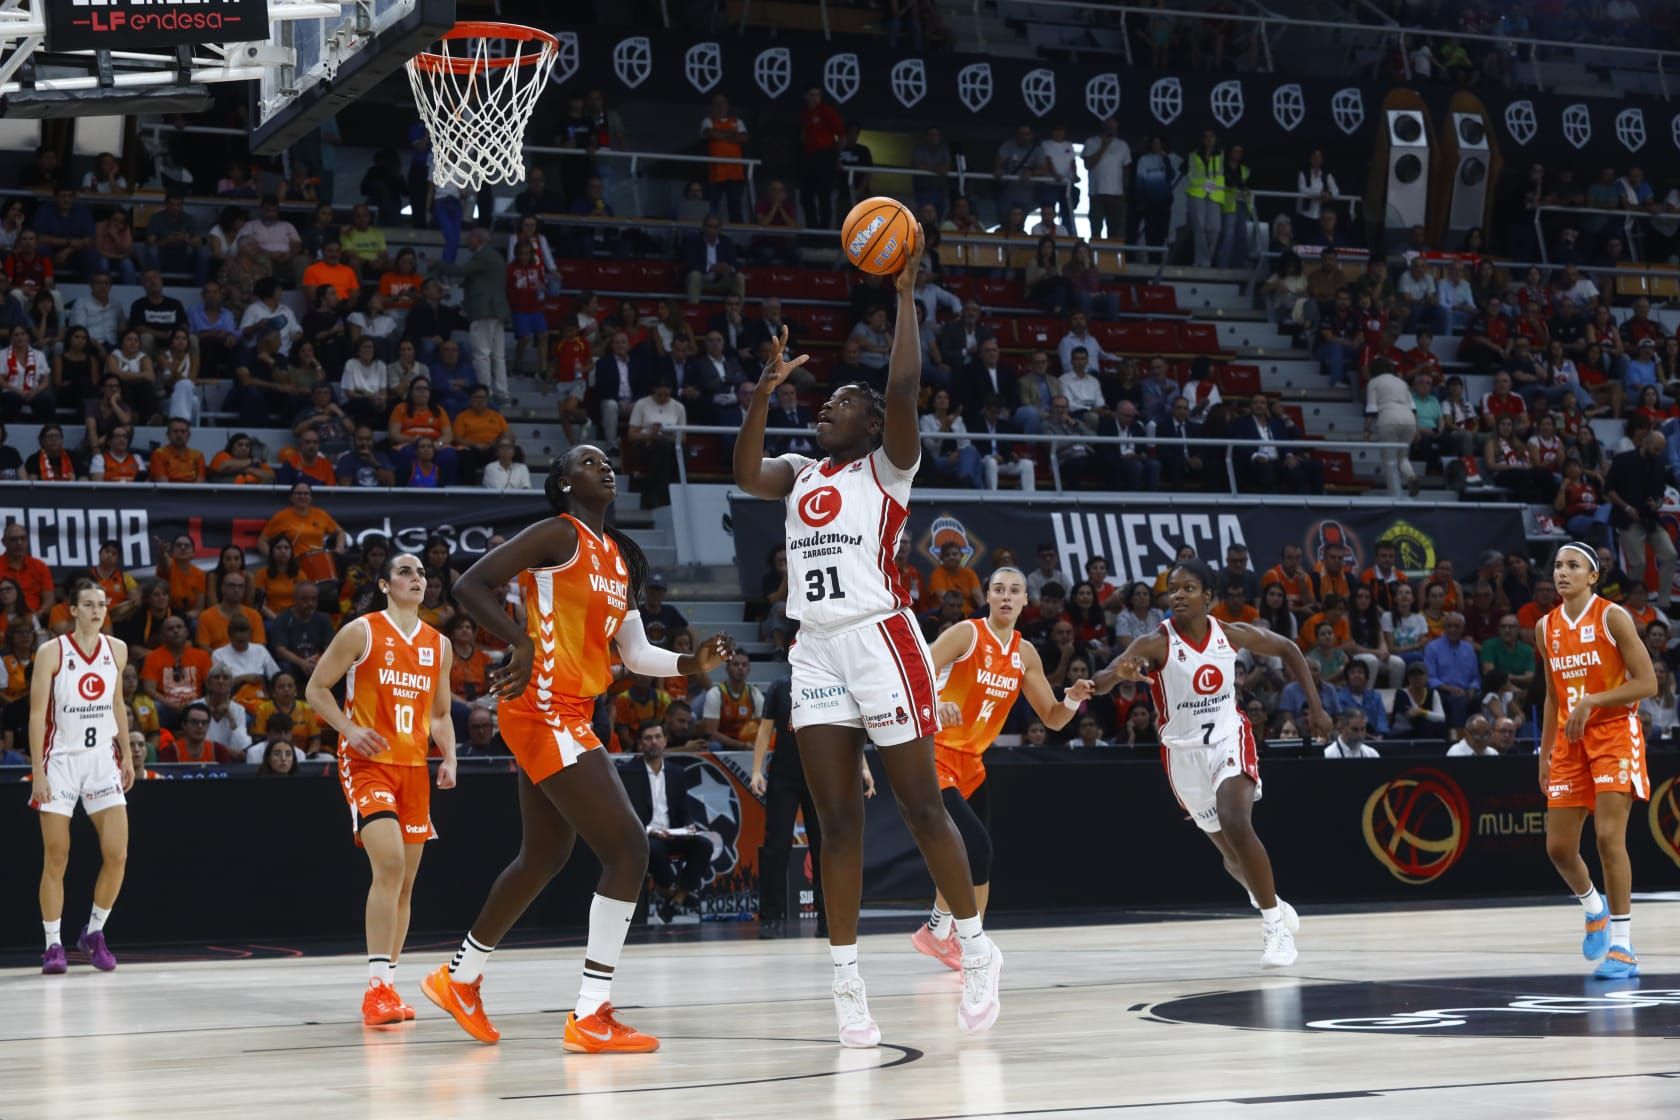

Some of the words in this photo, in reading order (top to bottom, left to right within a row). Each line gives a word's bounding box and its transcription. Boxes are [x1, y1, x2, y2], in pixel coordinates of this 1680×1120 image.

[91, 11, 126, 31] LF
[130, 9, 222, 30] endesa
[343, 517, 494, 553] desa
[787, 531, 863, 550] asademont
[803, 546, 843, 559] ZARAGOZA
[1051, 512, 1256, 588] HUESCA
[805, 566, 846, 602] 31
[1549, 650, 1602, 672] VALENCIA
[378, 668, 431, 693] VALENCIA
[1562, 668, 1588, 680] BASKET
[393, 687, 420, 700] BASKET
[801, 686, 847, 701] Silken
[985, 687, 1009, 699] BASKET
[810, 700, 839, 710] HOTELES
[976, 699, 996, 723] 14
[394, 703, 415, 734] 10
[84, 727, 97, 748] 8
[1201, 722, 1216, 745] 7
[1478, 811, 1549, 836] MUJE
